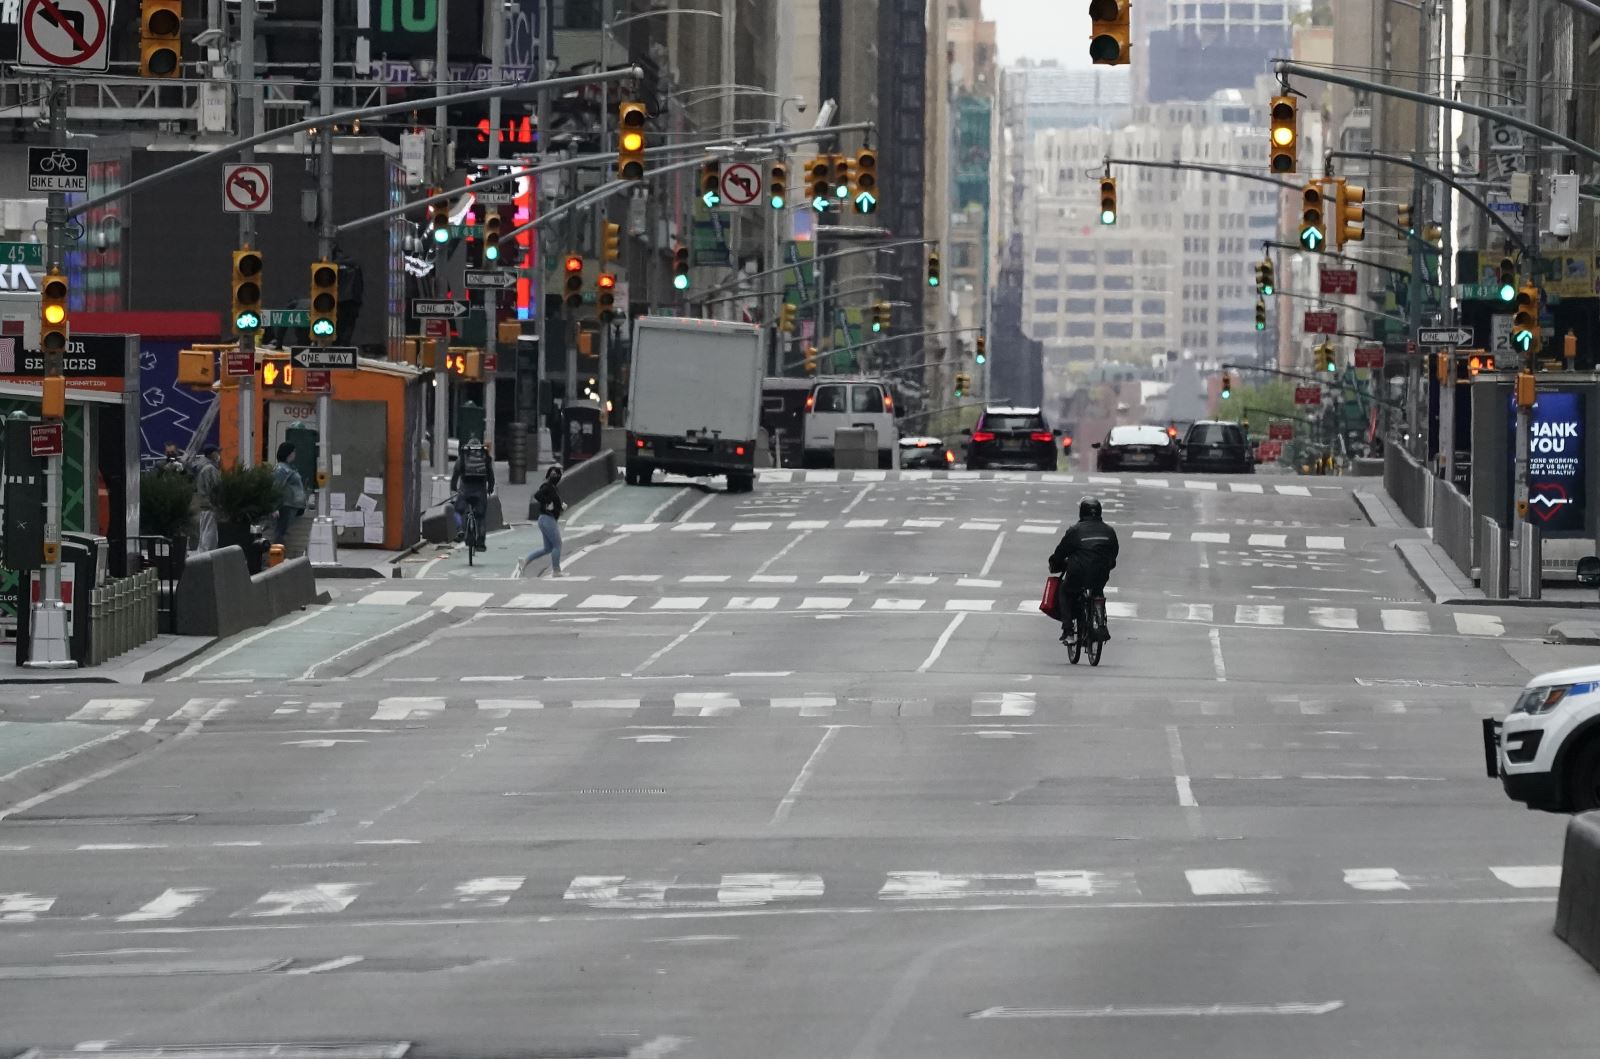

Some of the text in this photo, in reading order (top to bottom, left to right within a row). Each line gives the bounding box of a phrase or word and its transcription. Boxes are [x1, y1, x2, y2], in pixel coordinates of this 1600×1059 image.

[31, 178, 85, 188] BIKE LANE
[8, 246, 25, 263] 45
[420, 303, 461, 313] ONE WAY
[272, 312, 302, 325] W 44
[1423, 331, 1466, 341] ONE WAY
[301, 352, 349, 363] ONE WAY
[24, 358, 97, 370] SEICES
[1530, 422, 1578, 437] HANK
[1530, 438, 1565, 453] YOU
